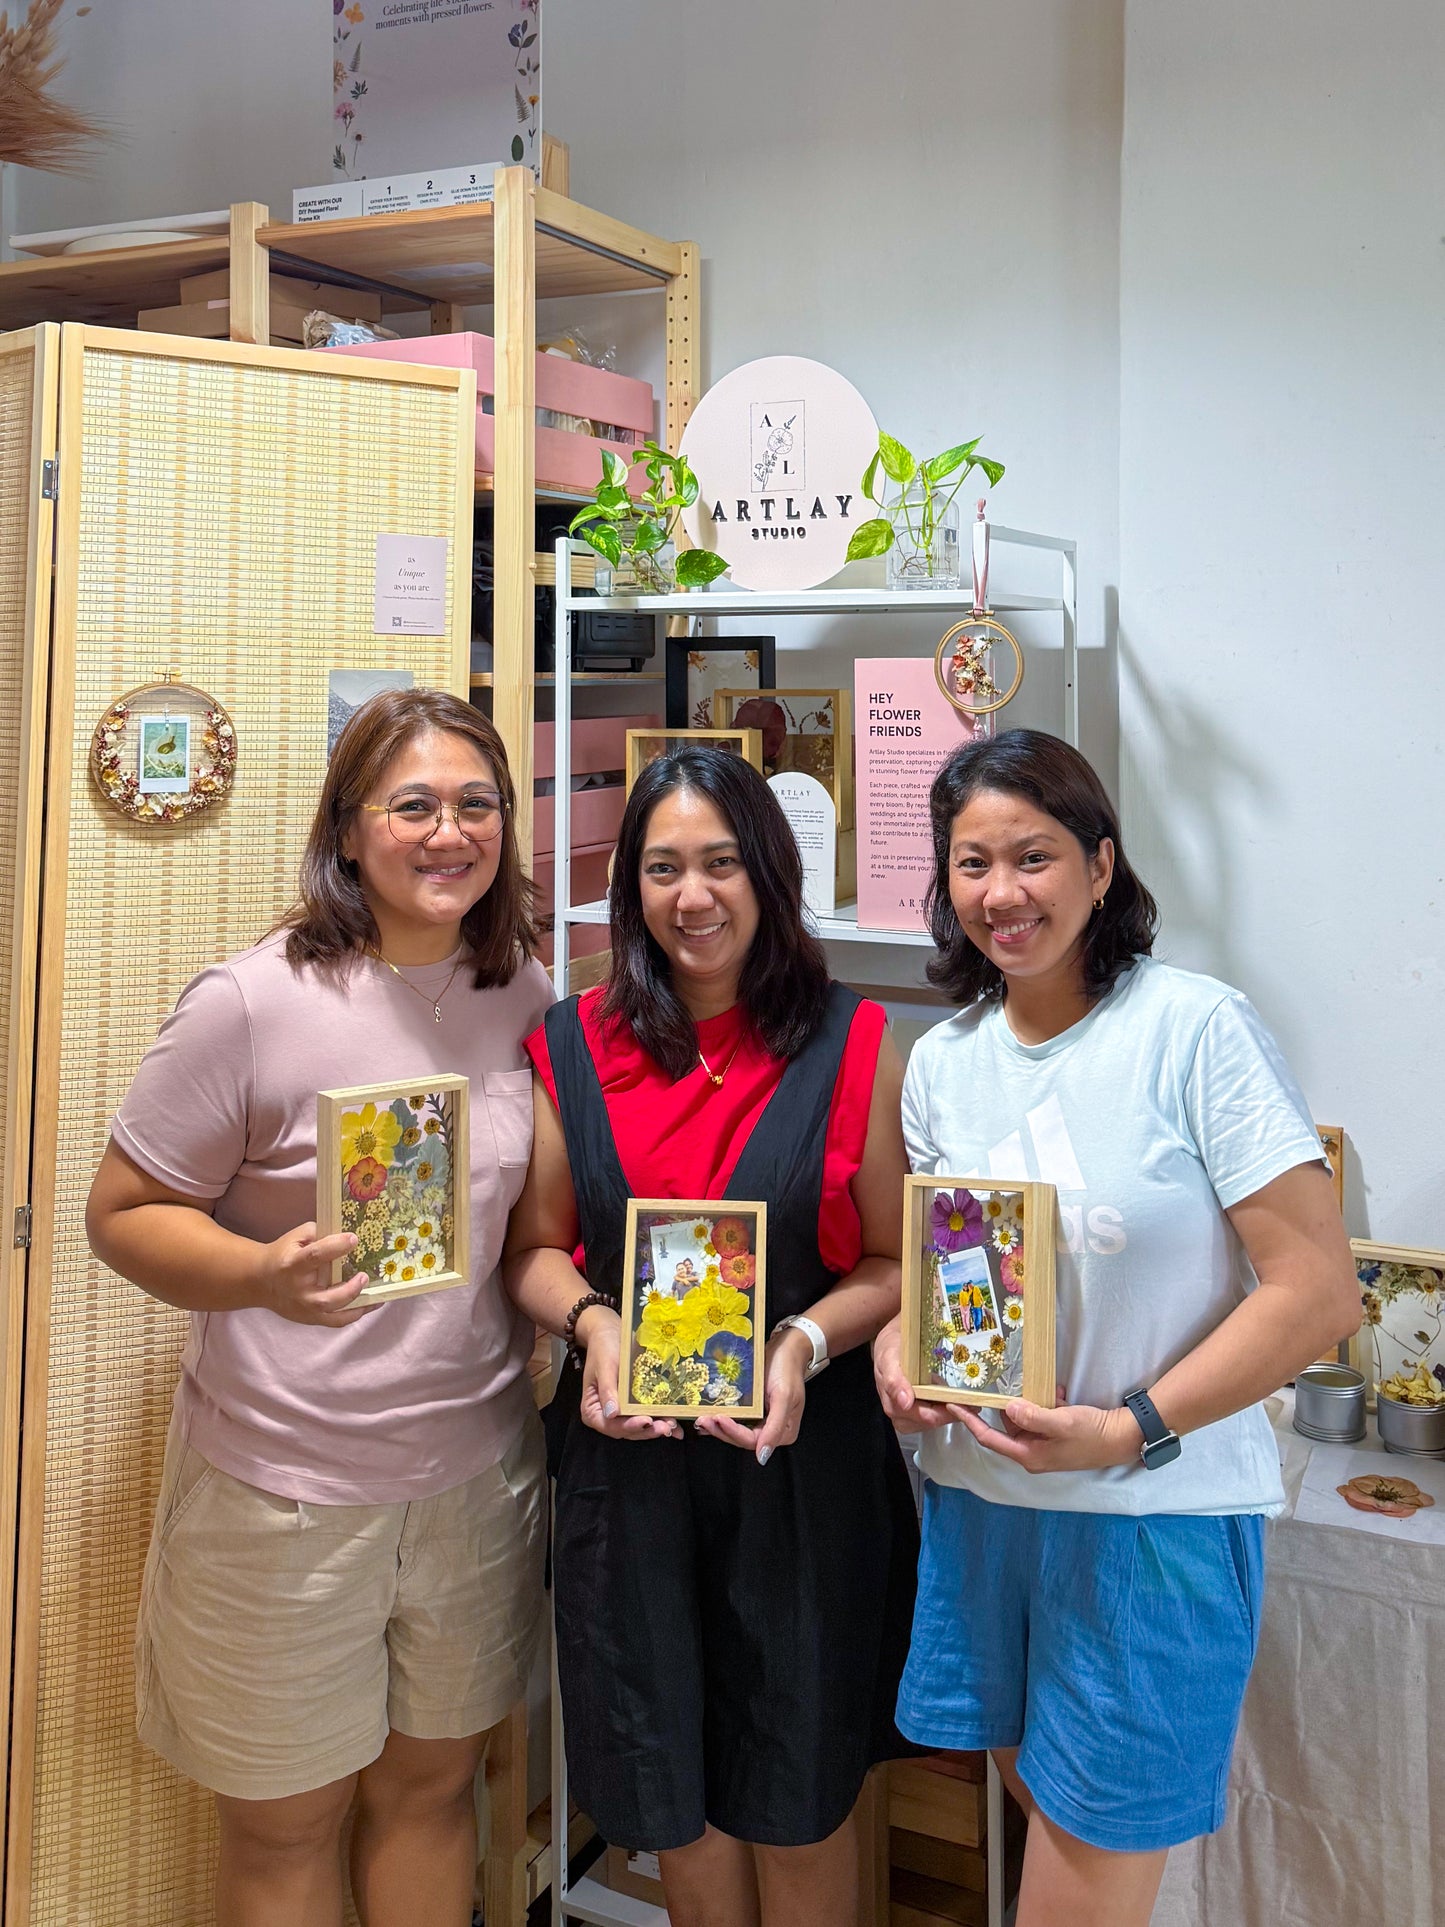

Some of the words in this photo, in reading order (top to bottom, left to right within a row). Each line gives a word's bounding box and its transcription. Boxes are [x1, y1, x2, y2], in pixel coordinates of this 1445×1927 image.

[383, 0, 430, 16] Celebrating
[375, 16, 412, 29] moments
[412, 12, 430, 22] with
[431, 6, 462, 23] pressed
[463, 3, 495, 14] flowers.
[469, 174, 476, 184] 3
[387, 185, 391, 195] 1
[427, 180, 433, 190] 2
[298, 200, 317, 208] CREATE
[318, 198, 331, 206] WITH
[326, 204, 339, 212] Floral
[760, 413, 773, 428] A
[783, 460, 795, 475] L
[710, 495, 853, 522] ARTLAY
[751, 526, 806, 541] STUDIO
[398, 567, 426, 580] Unique
[402, 584, 417, 592] you
[869, 693, 894, 704] HEY
[869, 709, 921, 720] FLOWER
[869, 726, 922, 737] FRIENDS
[869, 748, 885, 756] Artlay
[906, 749, 935, 757] specializes
[897, 855, 926, 863] preserving
